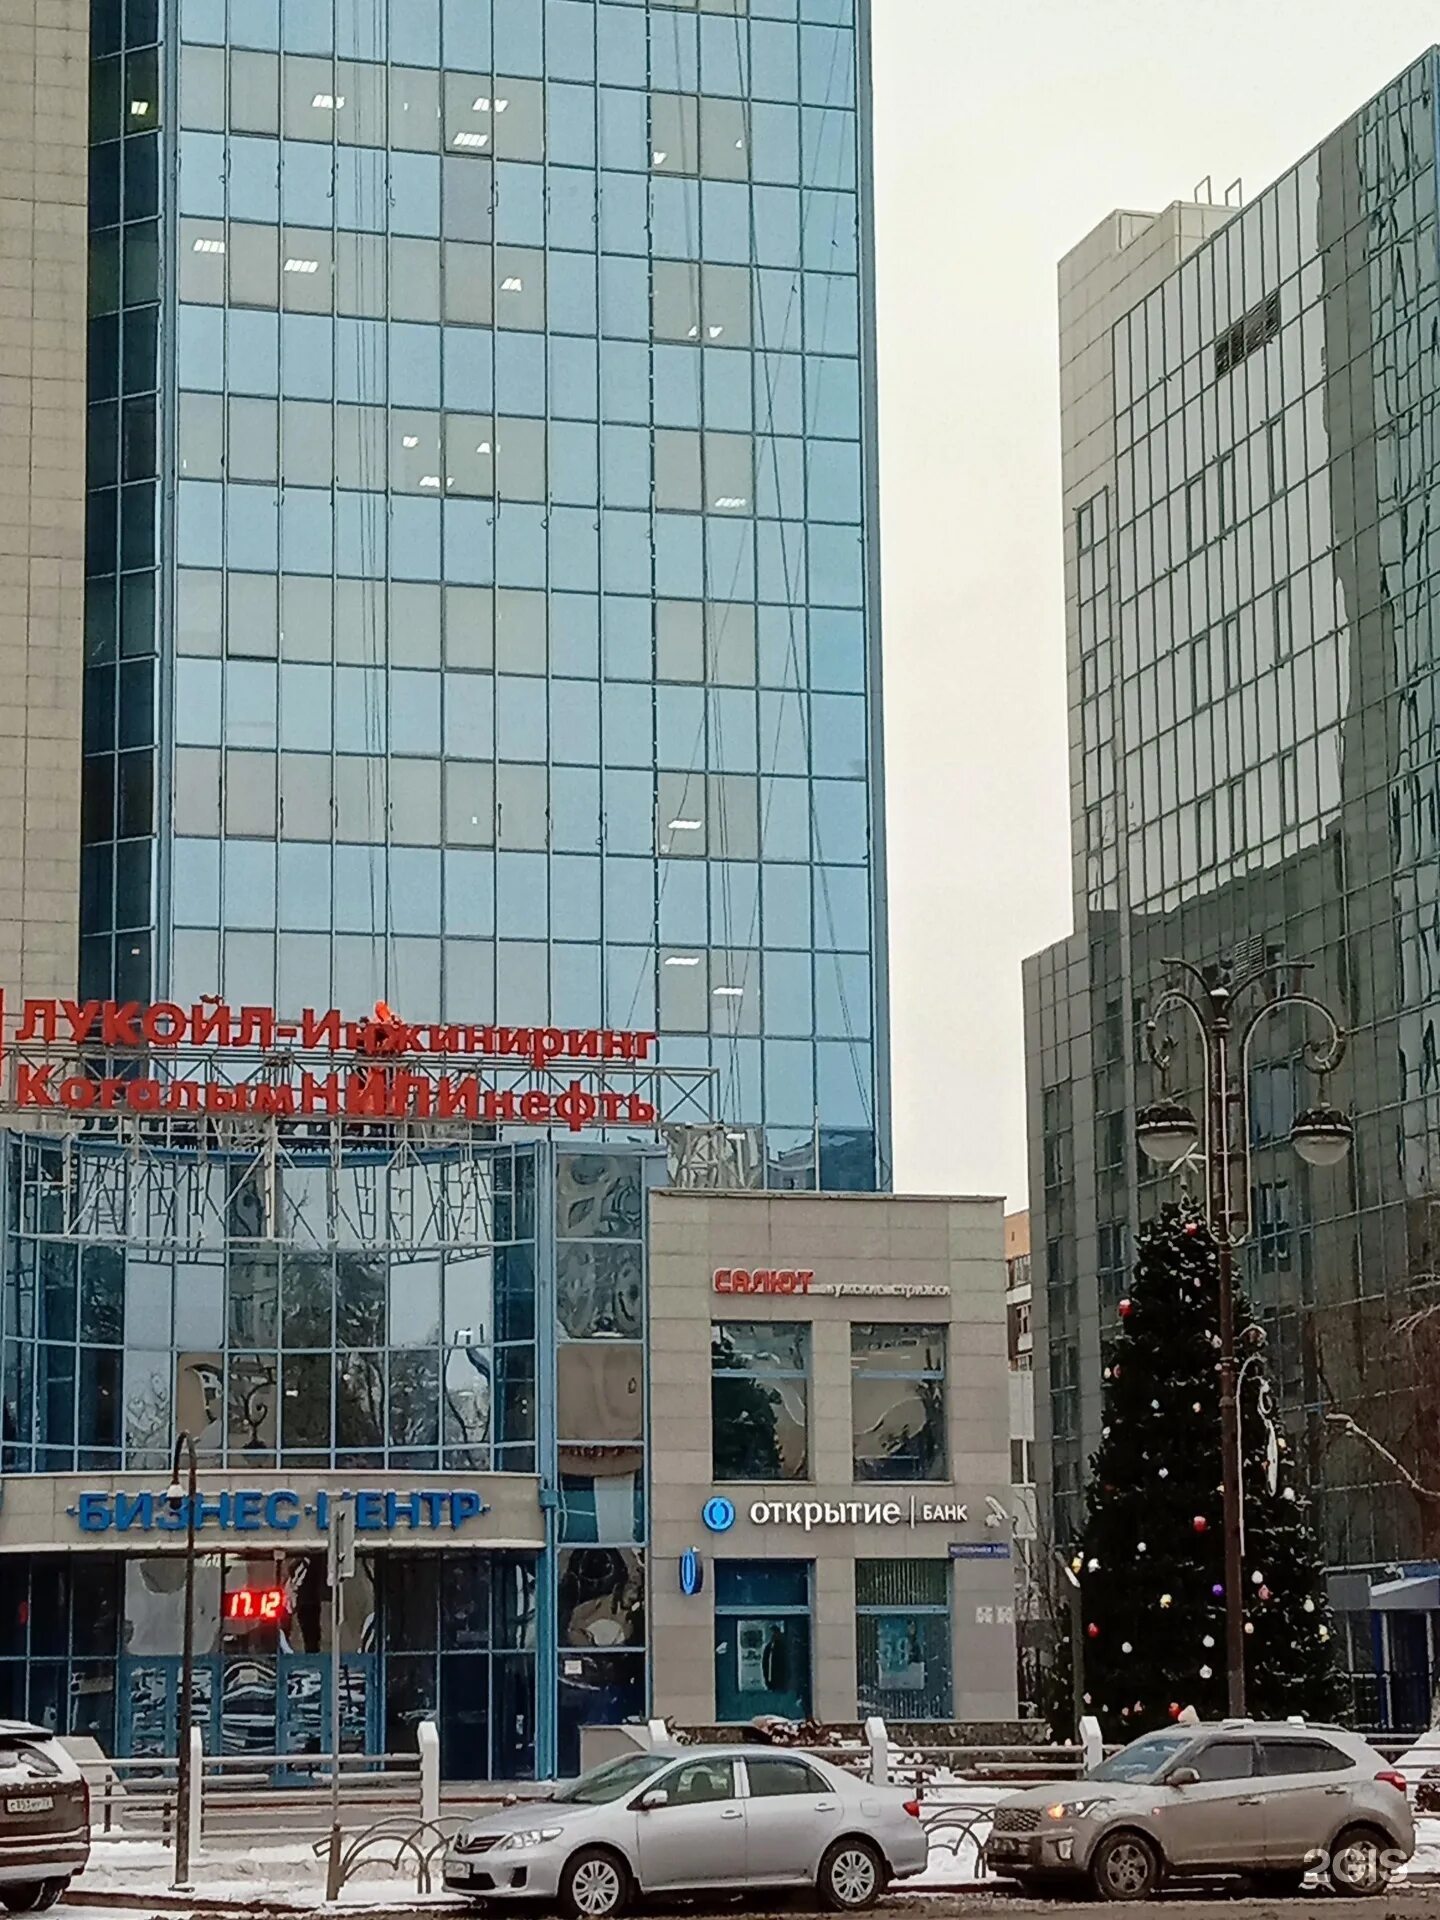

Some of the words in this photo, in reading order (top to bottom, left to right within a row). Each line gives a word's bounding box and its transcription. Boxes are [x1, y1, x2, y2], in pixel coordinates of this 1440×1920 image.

[16, 1063, 656, 1132] КогалымНИПИнефть
[713, 1268, 814, 1296] САЛЮТ
[78, 1489, 299, 1531] БИЗНЕС
[749, 1500, 902, 1531] открытие
[922, 1503, 969, 1522] БАНК
